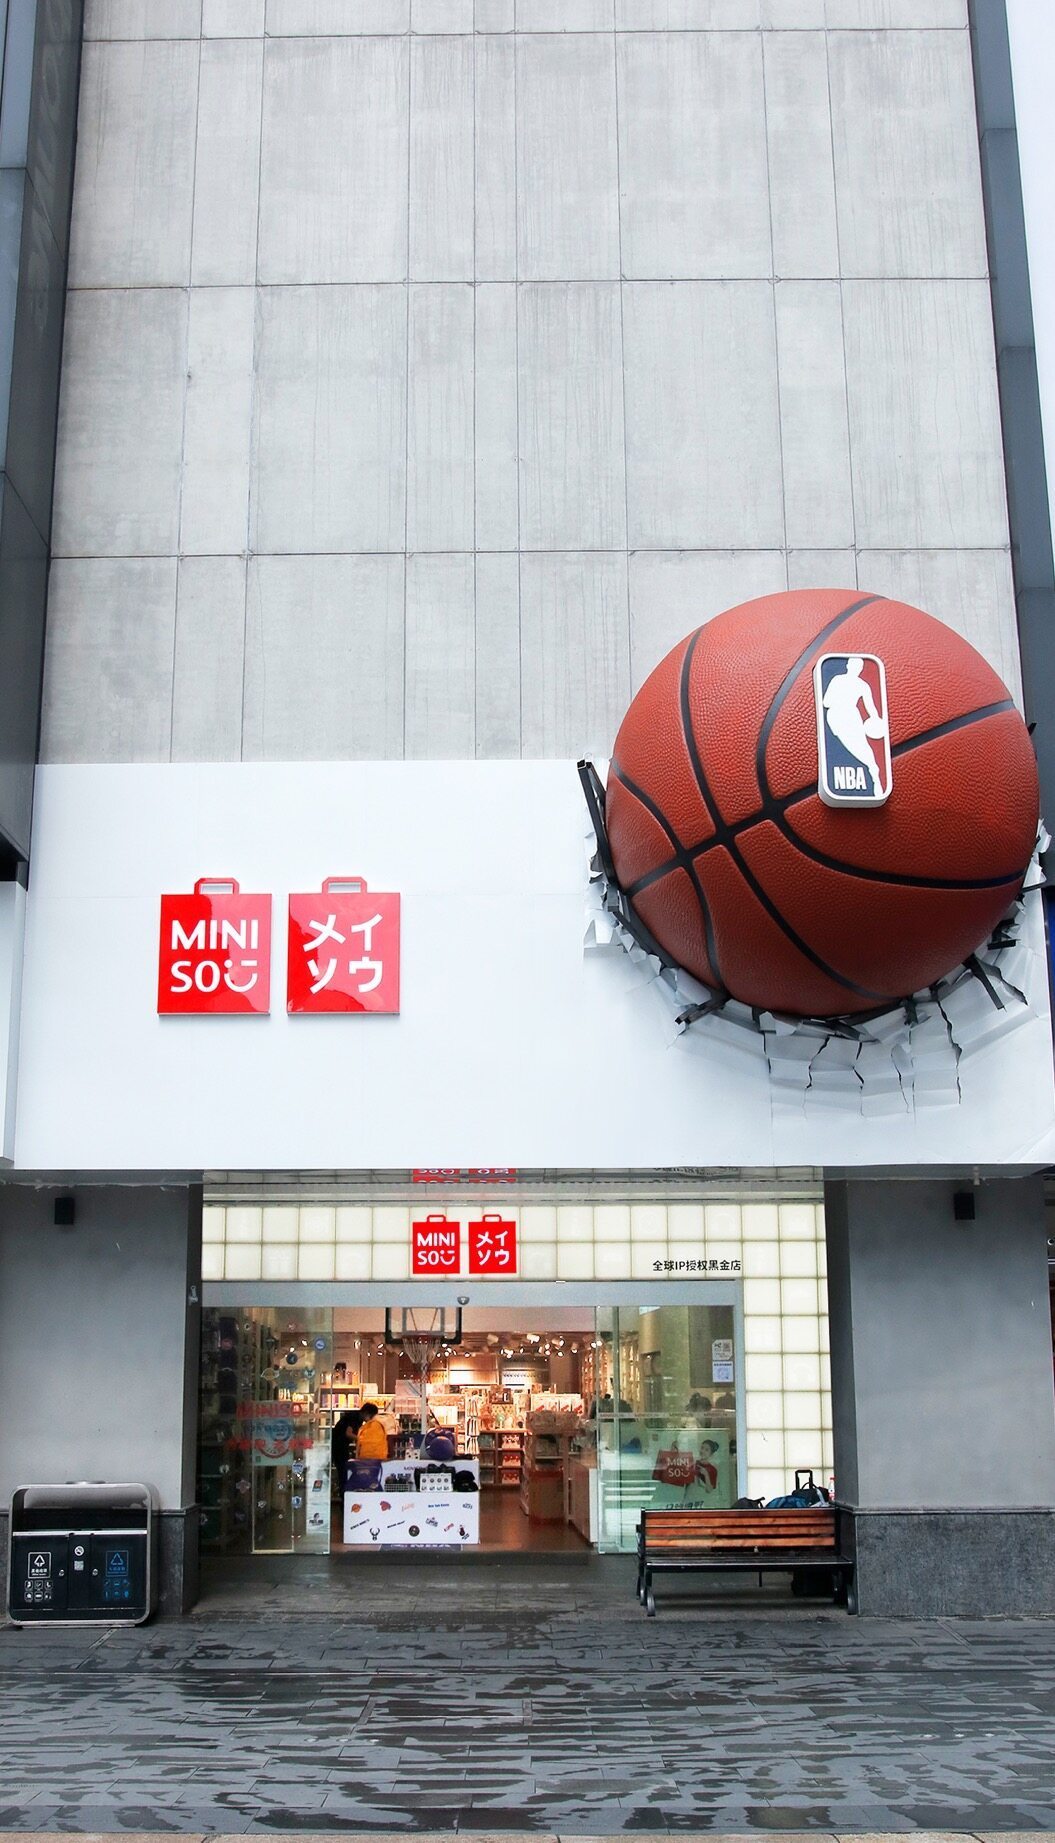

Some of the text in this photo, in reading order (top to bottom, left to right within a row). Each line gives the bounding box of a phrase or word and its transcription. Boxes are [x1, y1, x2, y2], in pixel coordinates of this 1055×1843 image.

[833, 766, 867, 790] NBA
[171, 919, 259, 950] MINI
[302, 913, 383, 952] メイ
[307, 956, 383, 994] ソウ
[417, 1232, 455, 1247] MINI
[475, 1231, 509, 1248] メイ
[477, 1249, 510, 1266] ソウ
[652, 1259, 742, 1272] 全球IP授权黑金店
